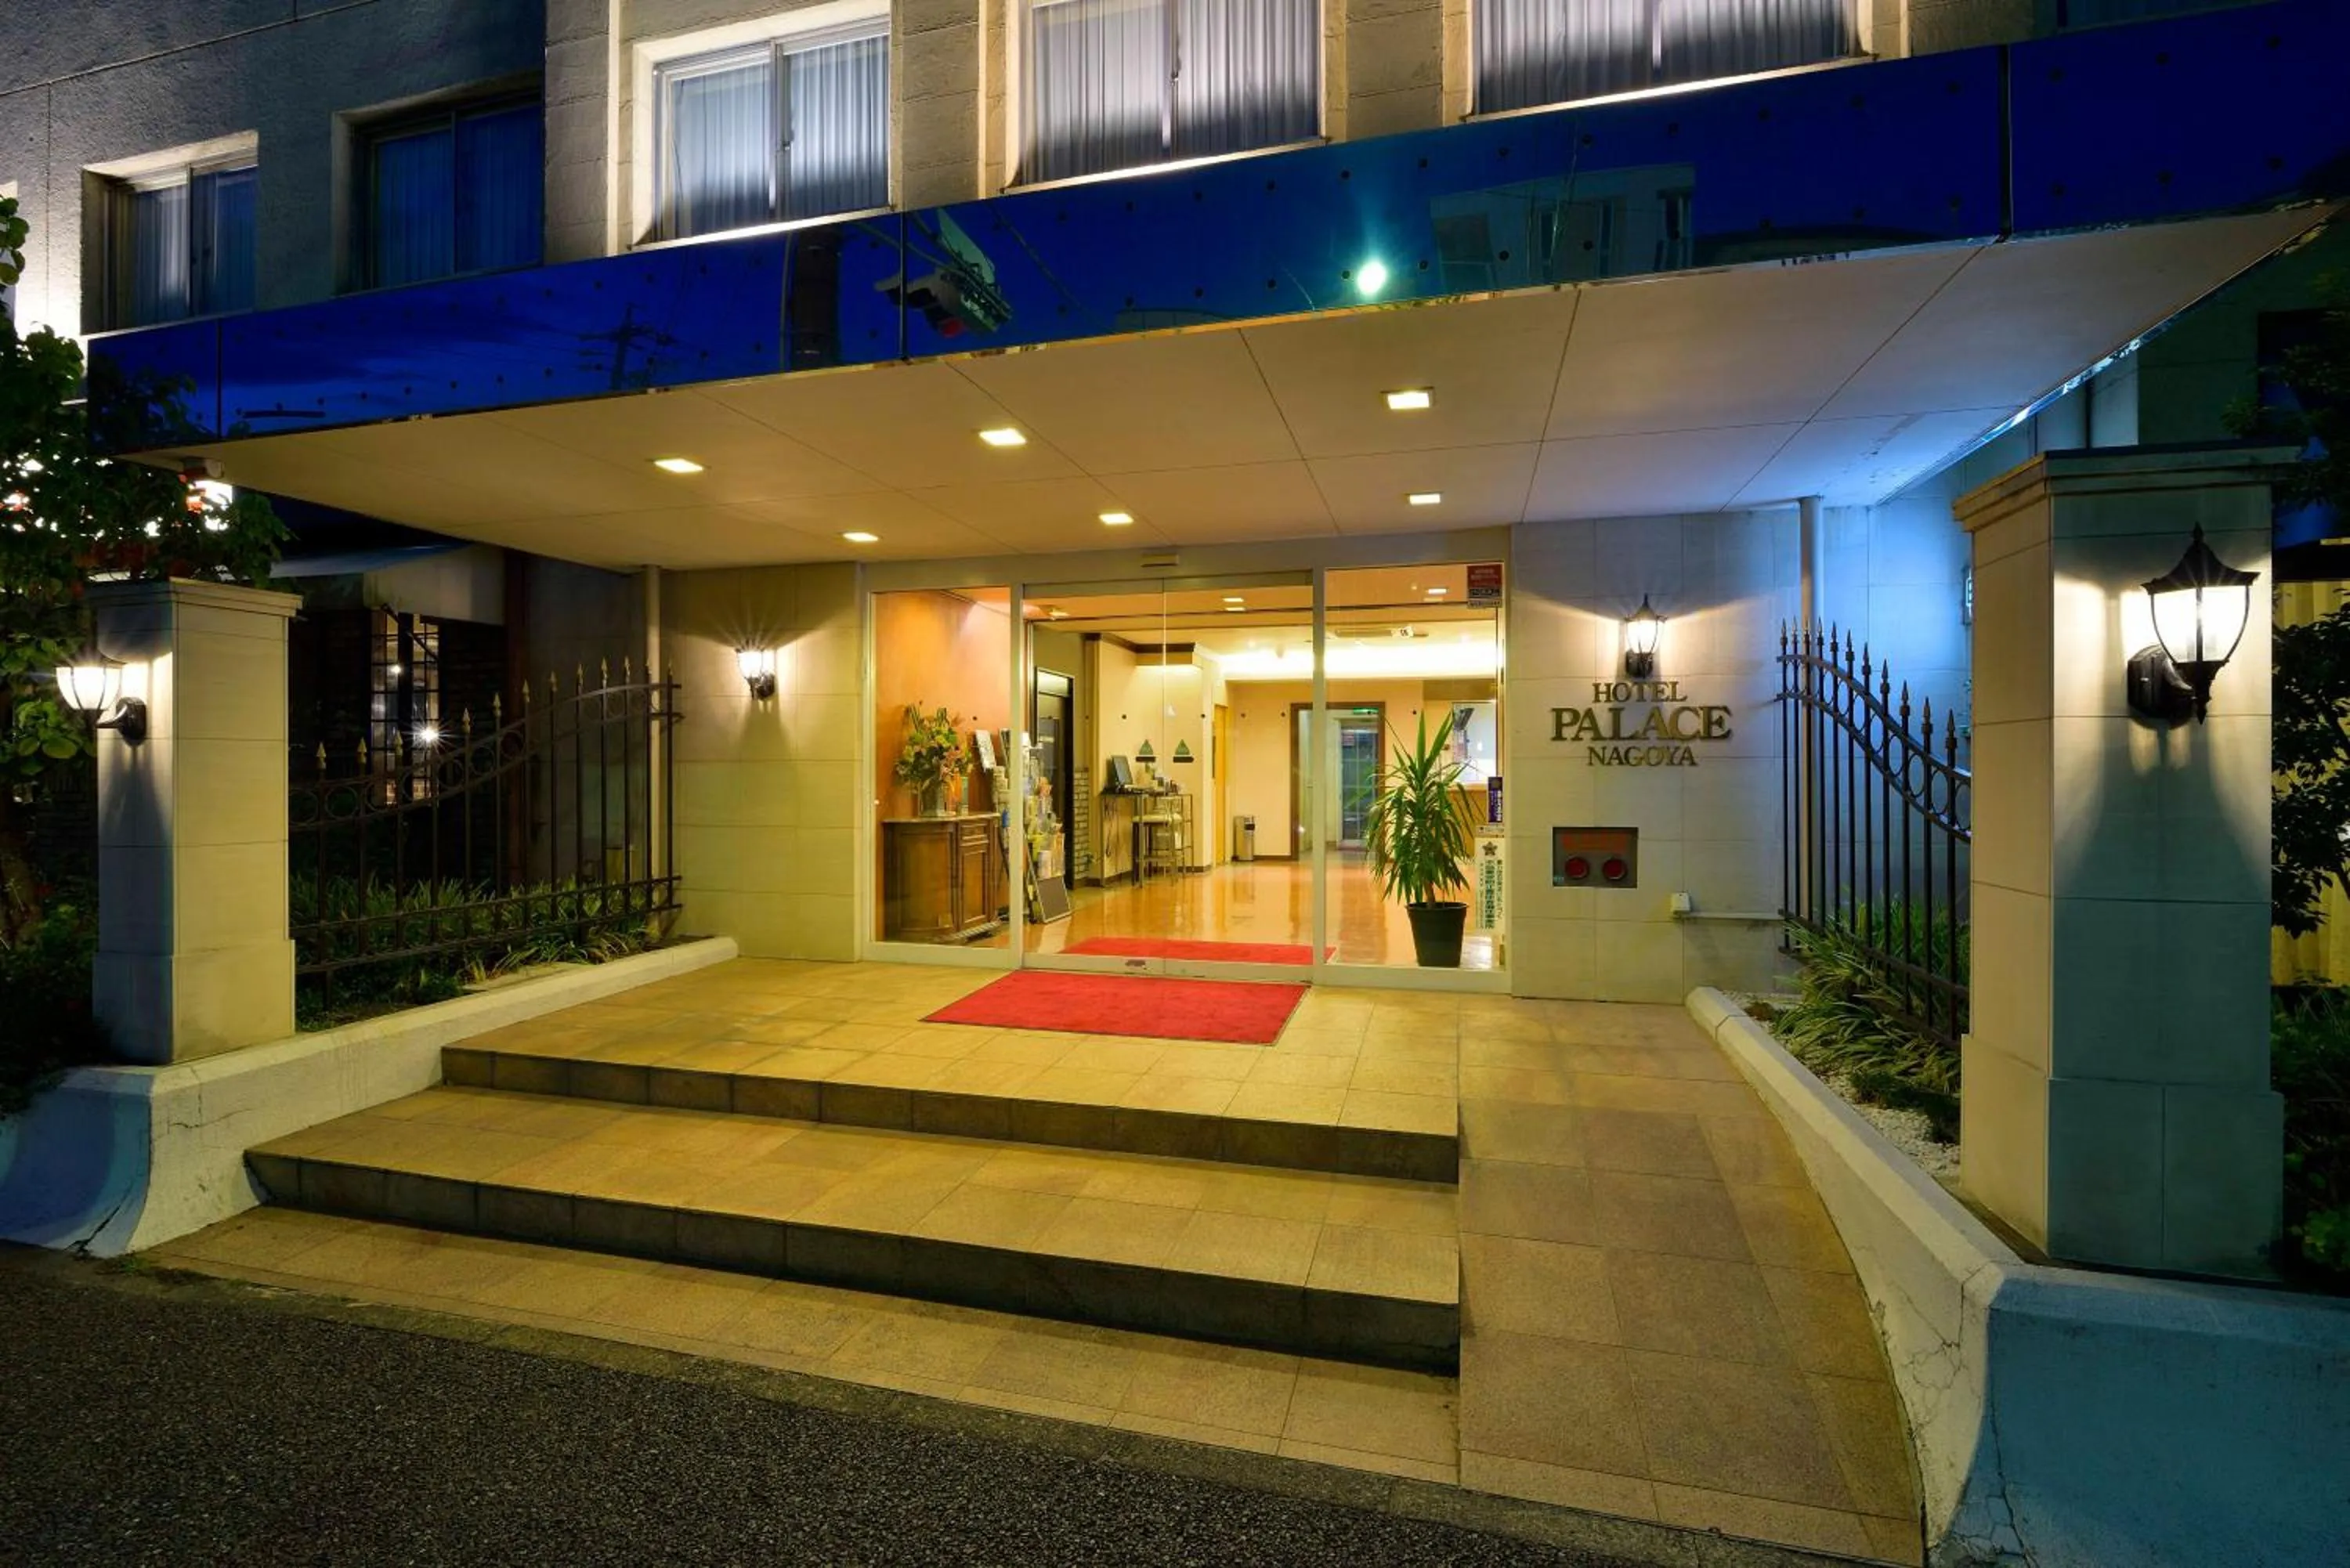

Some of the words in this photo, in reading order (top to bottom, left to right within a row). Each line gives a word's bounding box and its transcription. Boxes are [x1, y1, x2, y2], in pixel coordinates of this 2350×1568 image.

[1592, 681, 1687, 703] HOTEL
[1550, 706, 1733, 741] PALACE
[1587, 746, 1697, 767] NAGOYA
